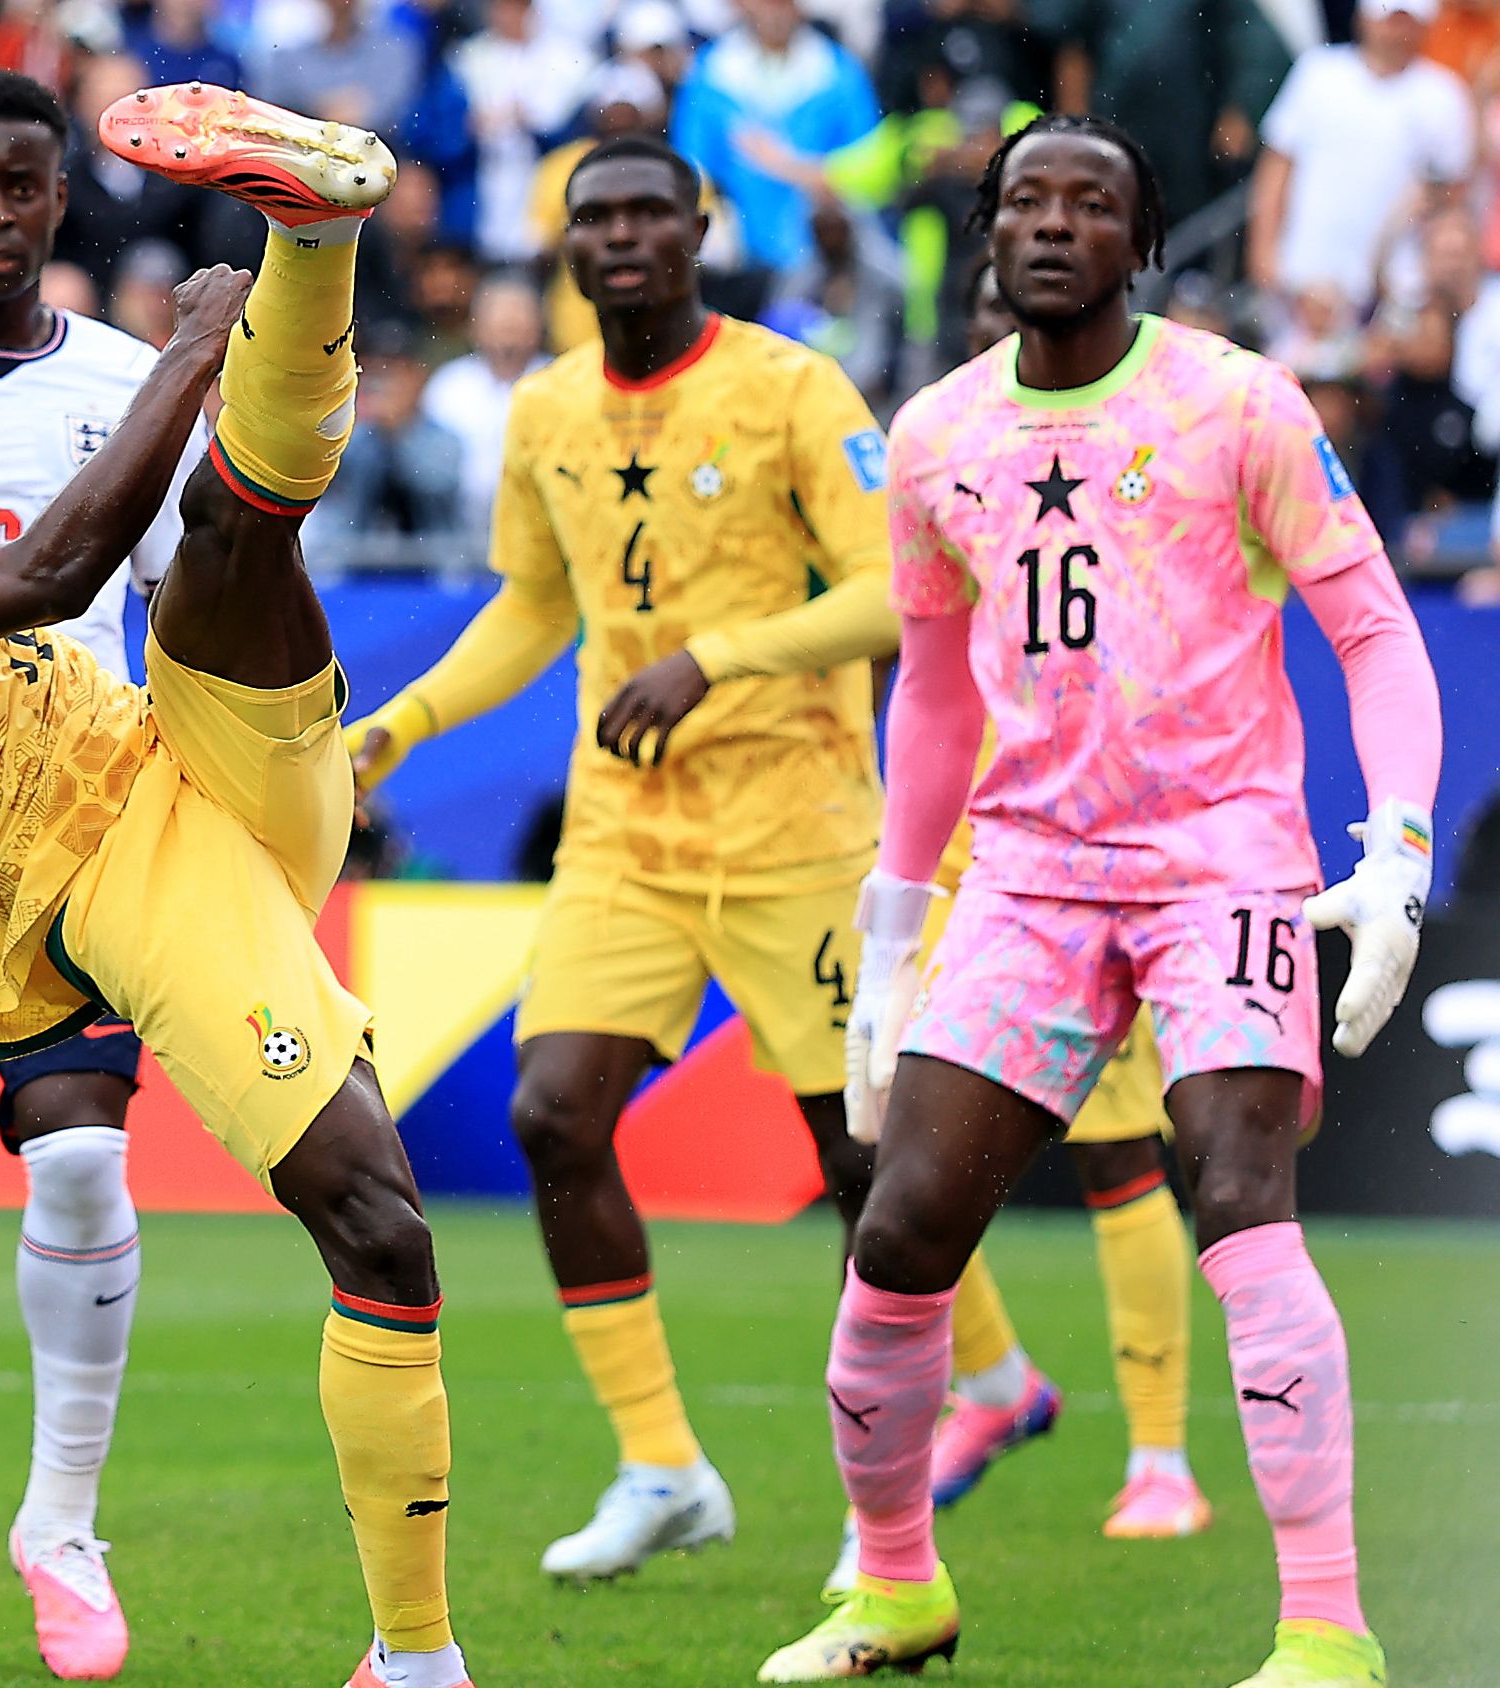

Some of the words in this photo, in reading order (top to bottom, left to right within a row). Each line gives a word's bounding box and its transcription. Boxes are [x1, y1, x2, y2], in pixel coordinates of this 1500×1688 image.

[623, 520, 653, 613] 4
[1017, 544, 1099, 655] 16
[814, 929, 849, 1006] 4
[1226, 908, 1296, 993] 16
